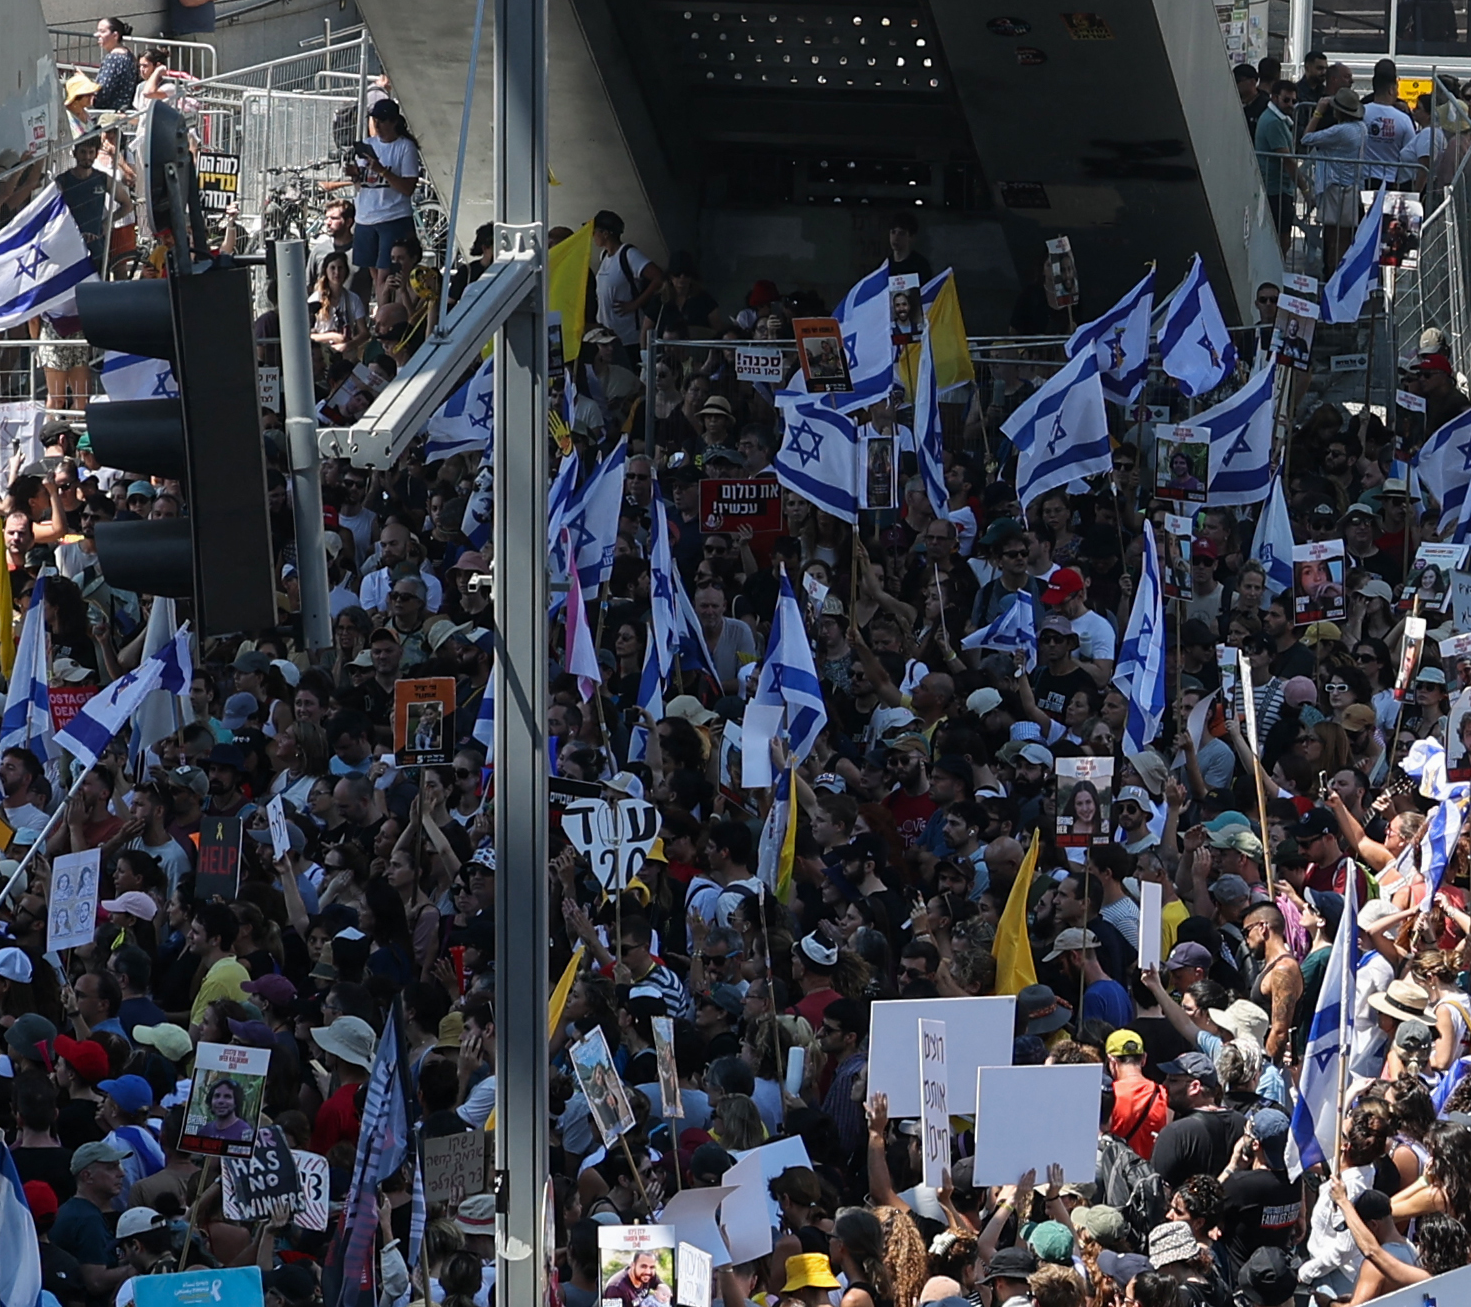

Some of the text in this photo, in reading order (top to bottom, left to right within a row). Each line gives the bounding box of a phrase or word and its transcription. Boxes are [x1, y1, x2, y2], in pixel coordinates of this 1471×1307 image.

[199, 156, 238, 171] למה הם
[737, 353, 782, 368] סכנה!
[760, 483, 780, 497] את
[712, 501, 758, 516] עכשיו!
[198, 845, 238, 875] HELP
[230, 1149, 281, 1178] HAS
[248, 1172, 280, 1194] NO
[237, 1190, 307, 1220] WINNERS
